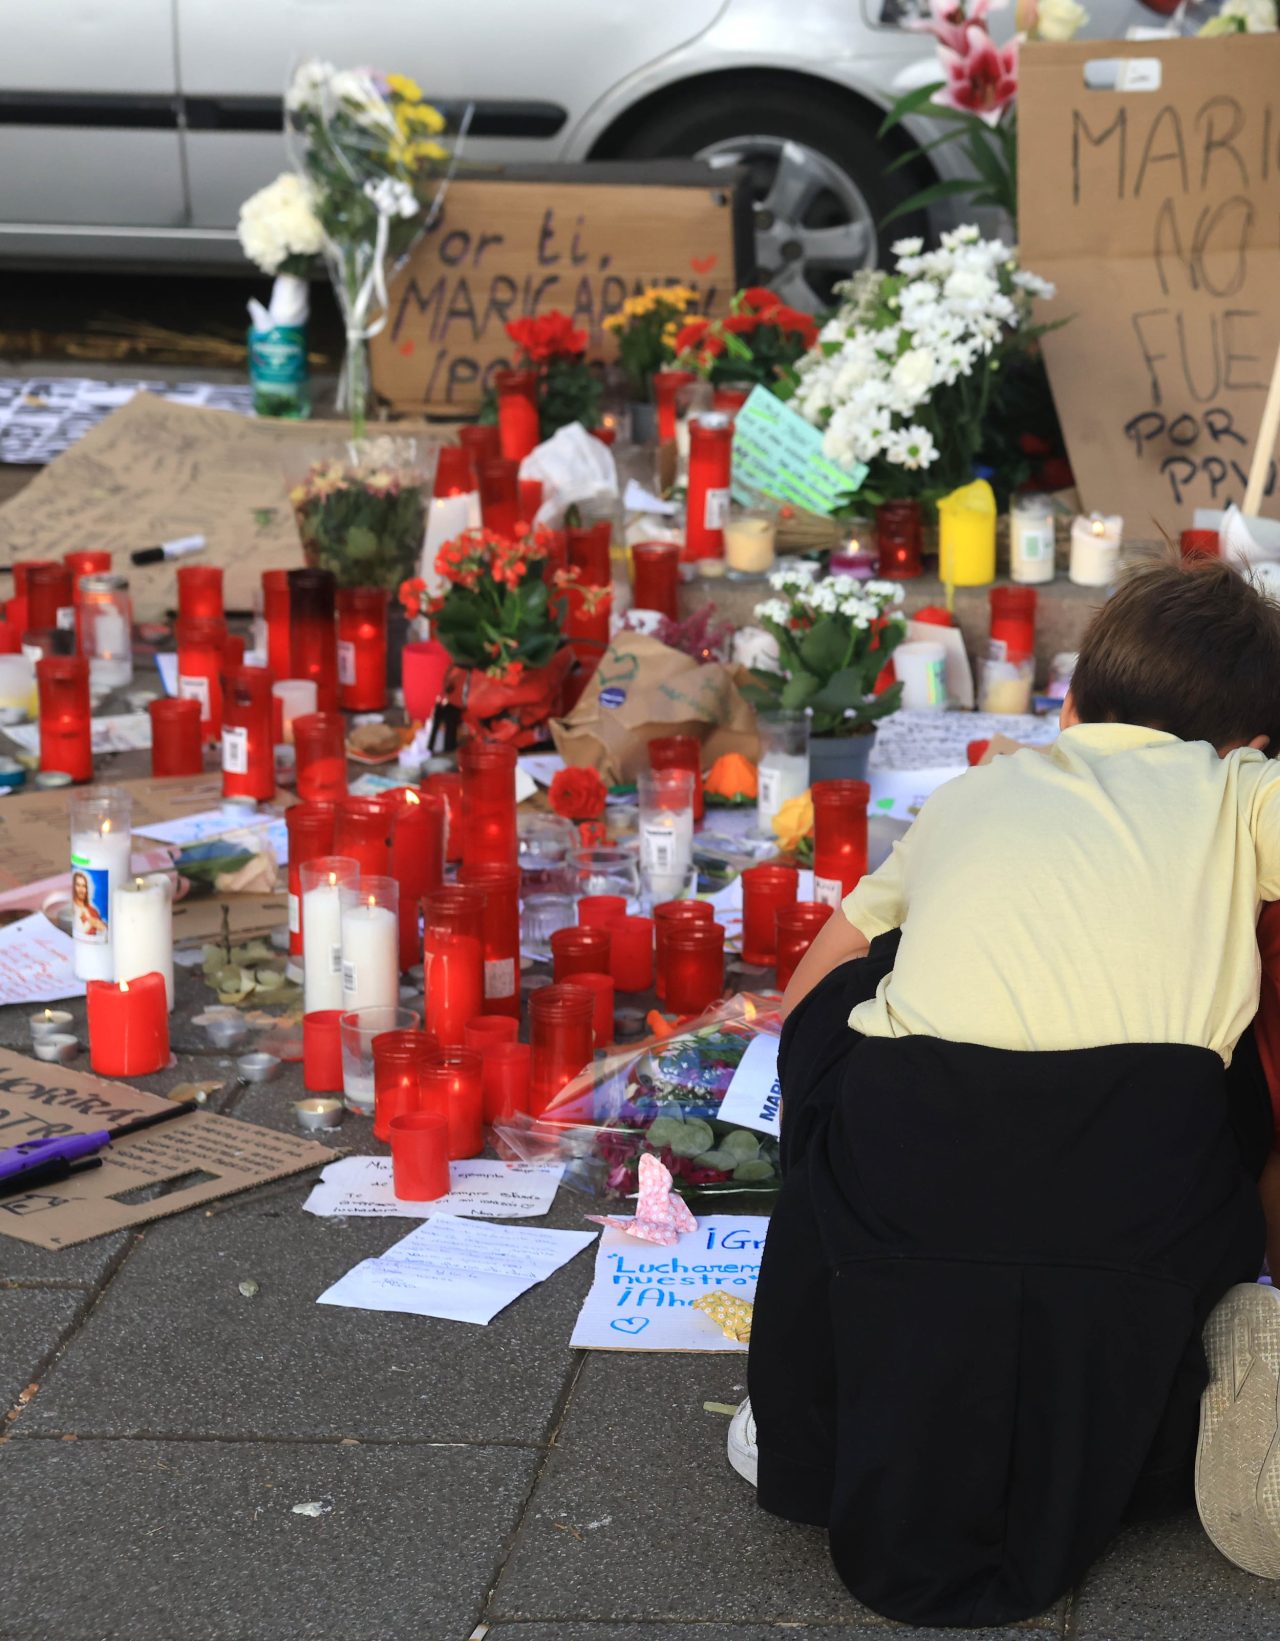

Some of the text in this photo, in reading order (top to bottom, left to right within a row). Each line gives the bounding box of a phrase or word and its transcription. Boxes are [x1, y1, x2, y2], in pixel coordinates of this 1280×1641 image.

[423, 211, 504, 268] or
[1153, 195, 1254, 299] NO
[390, 272, 719, 344] MARICAR
[1132, 307, 1270, 407] FUE
[1124, 410, 1248, 458] POR
[706, 1227, 765, 1250] ¡Gr
